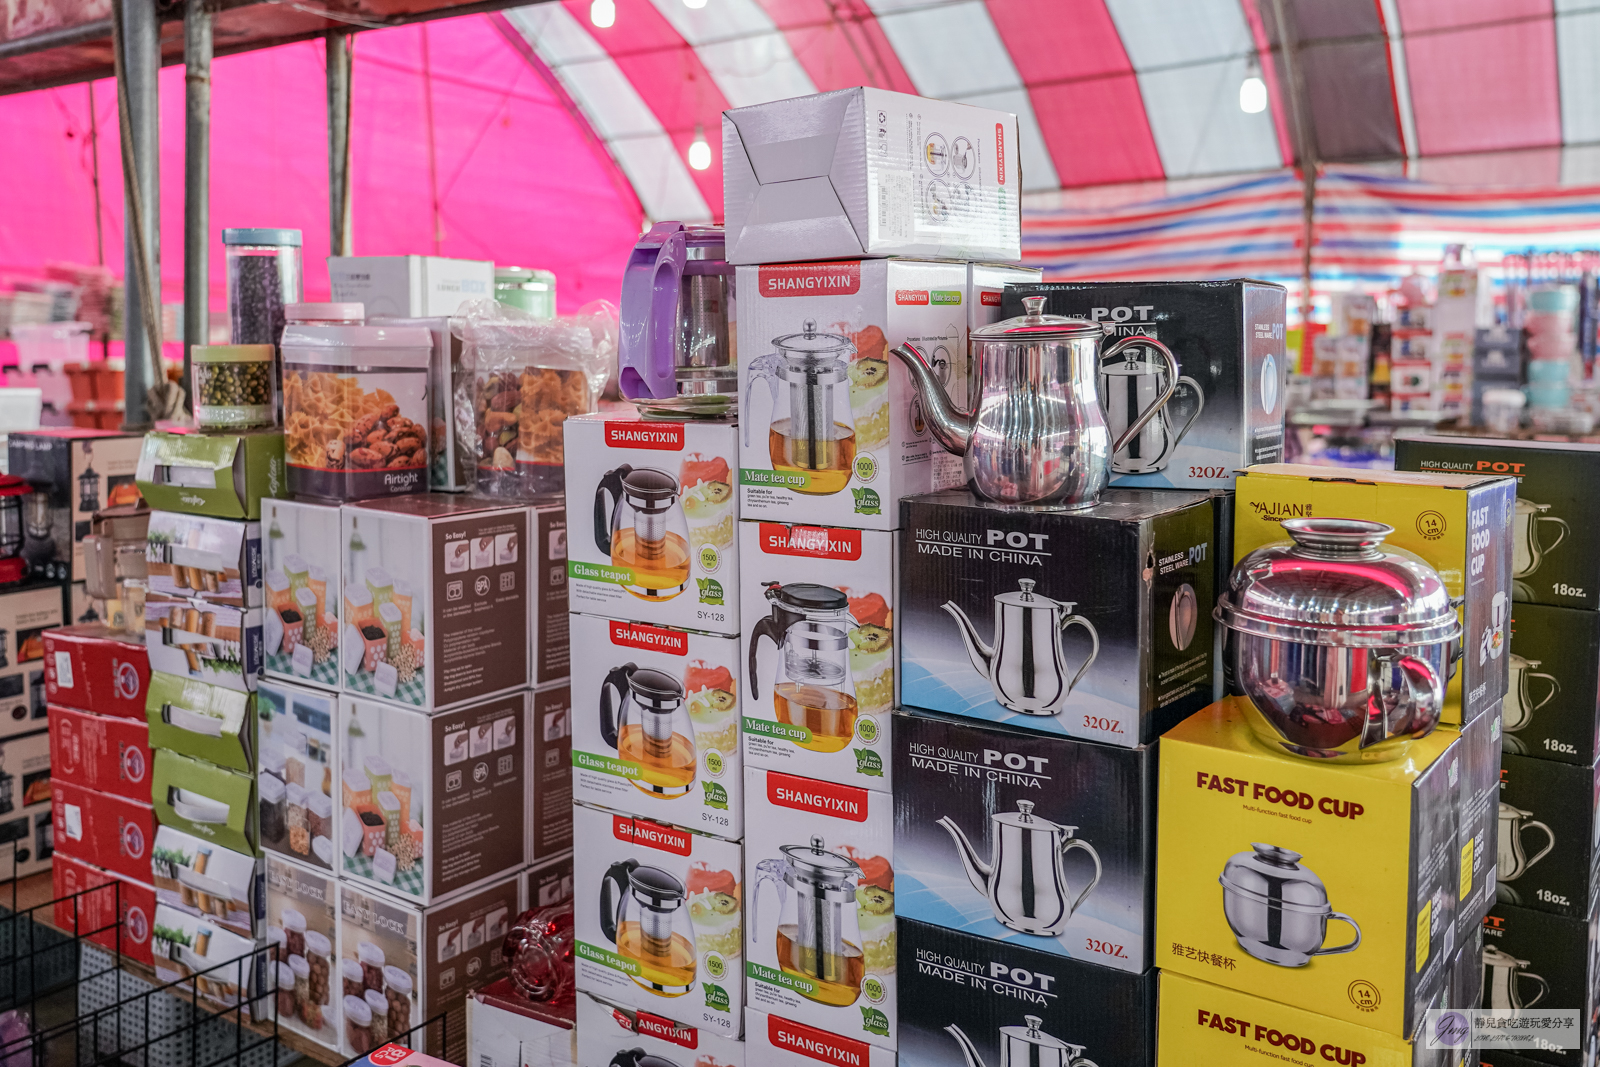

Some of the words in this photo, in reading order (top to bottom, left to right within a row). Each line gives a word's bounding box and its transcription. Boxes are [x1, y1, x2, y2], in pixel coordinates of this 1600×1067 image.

[768, 275, 851, 290] SHANGYIXIN
[898, 293, 927, 302] SHANGYIXIN
[1091, 305, 1154, 322] POT
[1272, 323, 1283, 340] POT
[611, 429, 678, 444] SHANGYIXIN
[857, 462, 872, 471] 1000
[1420, 460, 1441, 469] HIGH
[1441, 461, 1473, 471] QUALITY
[1476, 460, 1526, 473] POT
[384, 472, 418, 487] Airtight
[745, 471, 769, 483] Mate
[771, 474, 785, 484] tea
[788, 476, 805, 488] cup
[856, 495, 879, 509] glass
[1249, 501, 1304, 517] YAJIAN
[1425, 519, 1437, 528] 14
[1471, 506, 1489, 530] FAST
[453, 531, 466, 540] Easy!
[915, 528, 941, 541] HIGH
[942, 530, 982, 544] QUALITY
[986, 529, 1049, 550] POT
[1471, 529, 1490, 553] FOOD
[769, 536, 852, 553] SHANGYIXIN
[702, 554, 717, 562] 1500
[918, 543, 963, 558] MADE
[968, 548, 984, 559] IN
[989, 550, 1043, 566] CHINA
[1158, 551, 1184, 567] STAINLESS
[1189, 542, 1207, 566] POT
[574, 564, 599, 577] Glass
[601, 567, 631, 582] teapot
[1160, 564, 1175, 575] STEEL
[1175, 558, 1189, 570] WARE
[1470, 553, 1485, 576] CUP
[701, 585, 722, 599] glass
[1552, 583, 1587, 598] 18oz.
[697, 610, 725, 622] SY-128
[616, 628, 682, 648] SHANGYIXIN
[445, 725, 451, 733] So
[745, 719, 770, 732] Mate
[772, 725, 786, 736] tea
[788, 729, 806, 741] cup
[859, 723, 875, 734] 1000
[748, 736, 766, 744] Suitable
[1543, 738, 1577, 754] 18oz.
[578, 754, 605, 769] Glass
[606, 761, 638, 777] teapot
[708, 758, 722, 767] 1500
[858, 756, 881, 770] glass
[909, 742, 935, 756] HIGH
[937, 746, 979, 763] QUALITY
[983, 749, 1049, 774] POT
[911, 757, 958, 775] MADE
[964, 766, 981, 778] IN
[986, 770, 1042, 789] CHINA
[706, 790, 727, 802] glass
[776, 787, 858, 815] SHANGYIXIN
[1197, 771, 1249, 797] FAST
[1253, 783, 1314, 810] FOOD
[1317, 797, 1364, 820] CUP
[702, 813, 729, 827] SY-128
[1243, 804, 1278, 817] Multi-function
[1279, 811, 1288, 819] fast
[1289, 814, 1301, 822] food
[619, 823, 686, 849] SHANGYIXIN
[1473, 857, 1481, 873] CUP
[296, 880, 323, 900] LOCK
[1536, 889, 1570, 906] 18oz.
[343, 900, 371, 920] EASY
[373, 912, 404, 934] LOCK
[579, 944, 605, 962] Glass
[606, 953, 637, 973] teapot
[708, 959, 723, 970] 1500
[1171, 942, 1237, 971] 雅艺快餐杯
[916, 948, 941, 964] HIGH
[944, 956, 985, 975] QUALITY
[990, 961, 1055, 991] POT
[752, 965, 776, 980] Mate
[778, 973, 793, 986] tea
[794, 980, 813, 993] cup
[755, 981, 773, 991] Suitable
[918, 963, 965, 985] MADE
[971, 975, 986, 990] IN
[992, 983, 1048, 1007] CHINA
[865, 983, 882, 993] 1000
[1358, 990, 1371, 998] 14
[707, 990, 728, 1006] glass
[703, 1012, 731, 1029] SY-128
[865, 1015, 888, 1029] glass
[1198, 1009, 1250, 1038] FAST
[1255, 1024, 1316, 1055] FOOD
[1319, 1044, 1366, 1067] CUP
[1533, 1037, 1567, 1055] 18oz.
[777, 1031, 860, 1066] SHANGYIXIN
[1244, 1044, 1280, 1059] Multi-function
[1280, 1054, 1291, 1063] fast
[1291, 1057, 1303, 1066] food
